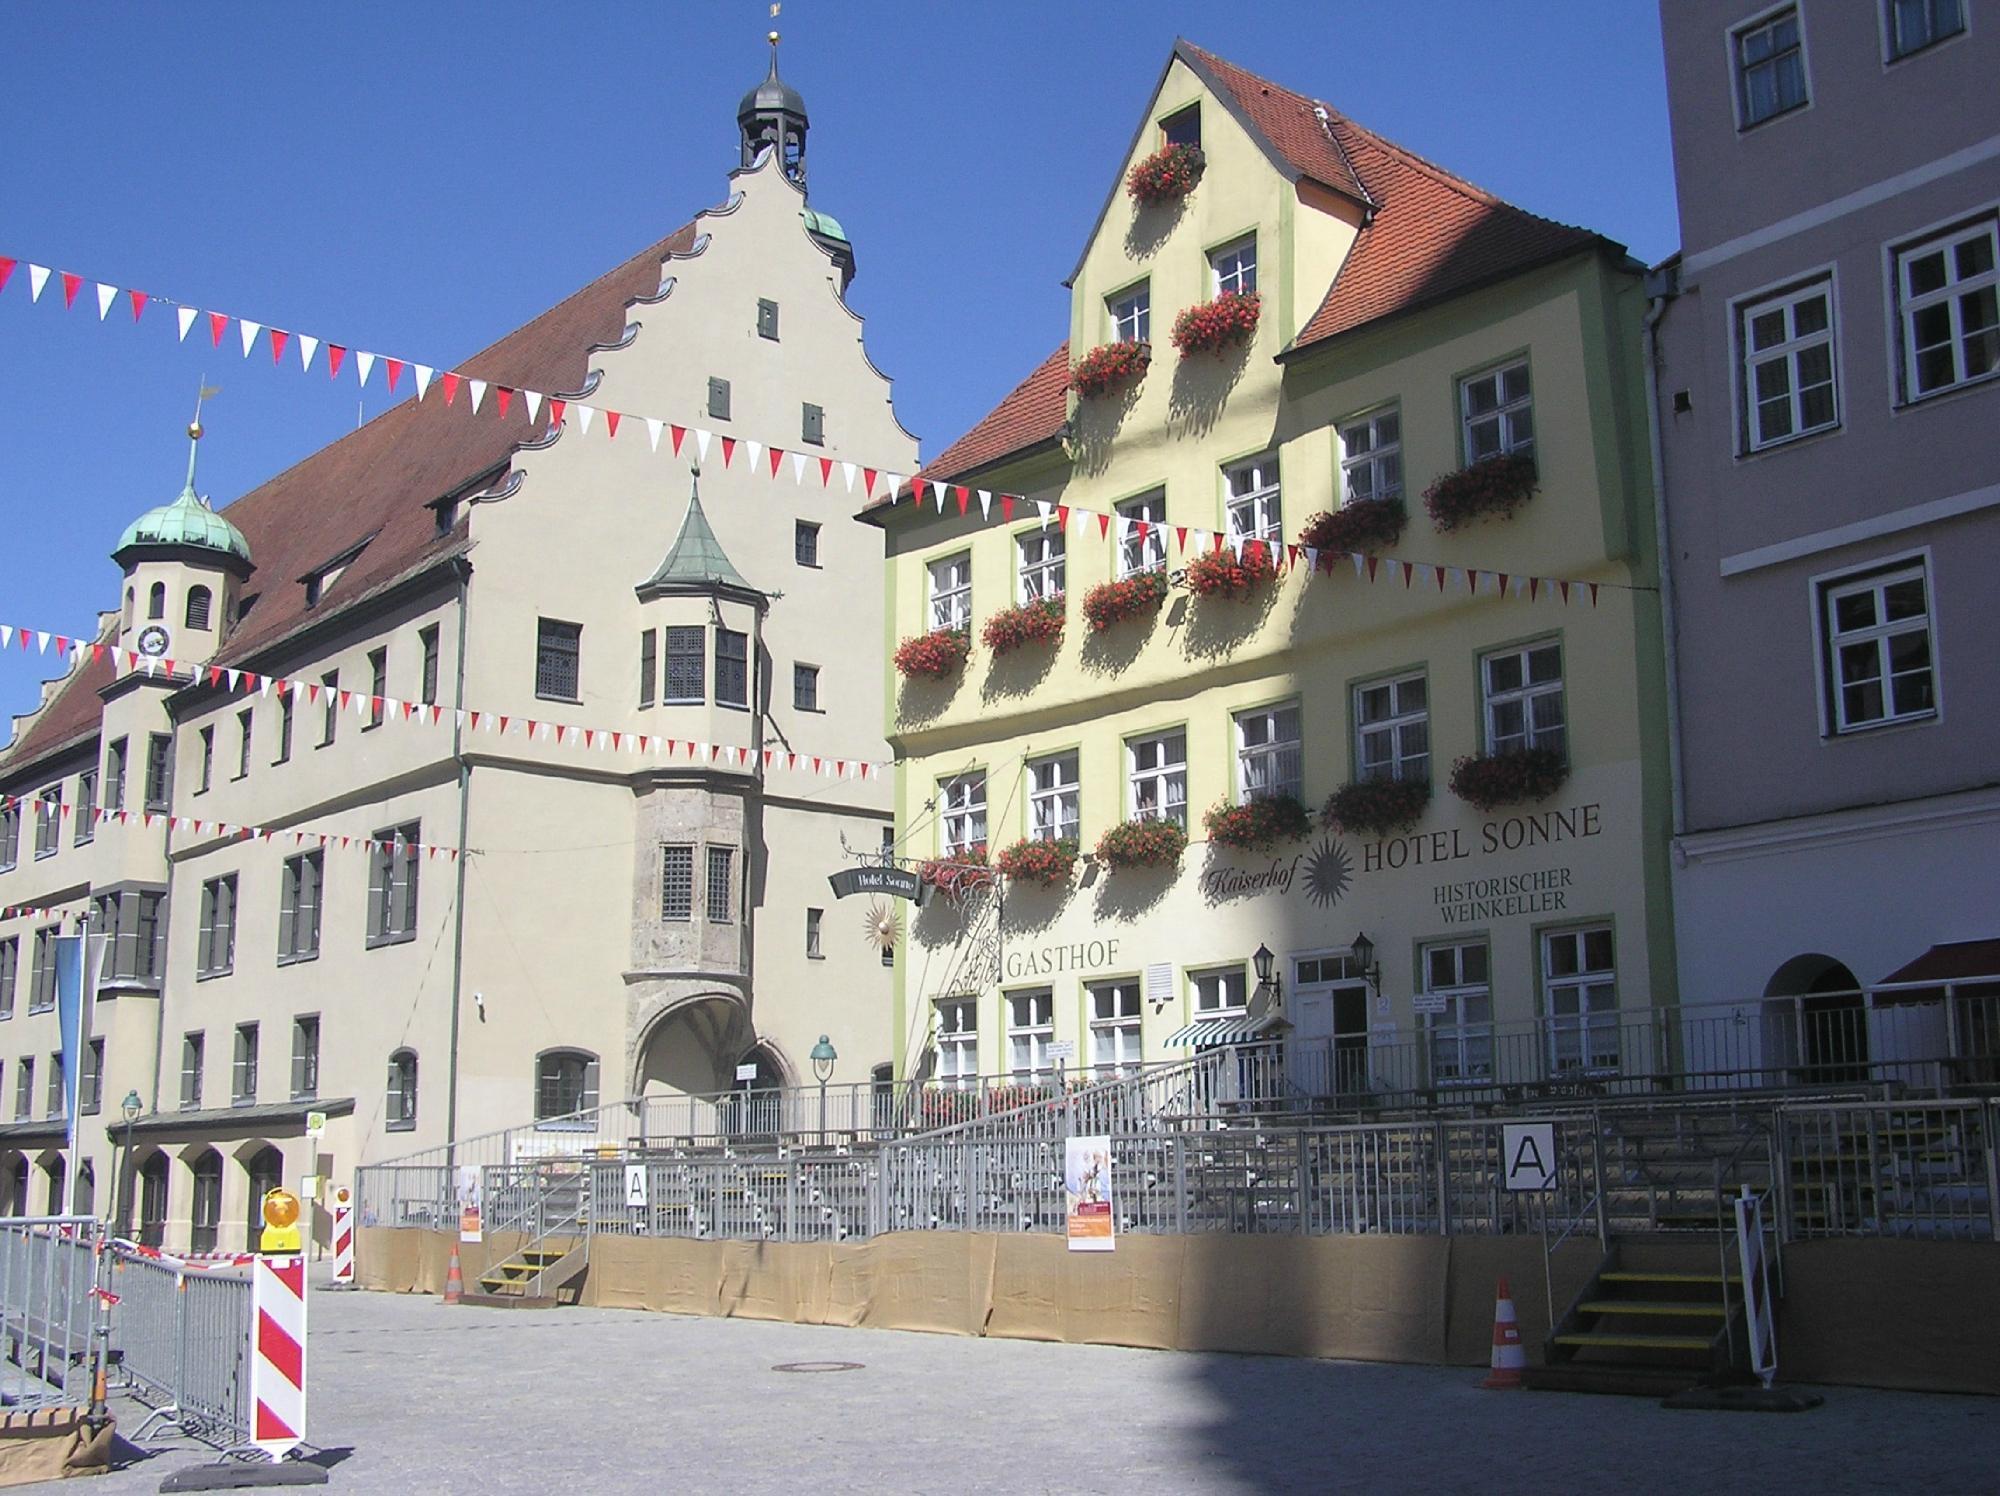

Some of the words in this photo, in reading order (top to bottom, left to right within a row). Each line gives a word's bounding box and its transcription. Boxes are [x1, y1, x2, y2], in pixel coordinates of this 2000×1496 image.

[1363, 828, 1470, 873] HOTEL
[1482, 803, 1602, 854] SONNE
[858, 873, 882, 887] Hotel
[1206, 855, 1302, 896] Kaiserhof
[1433, 868, 1573, 905] HISTORISCHER
[1441, 891, 1566, 924] WEINKELLER
[1007, 939, 1121, 978] GASTHOF
[1510, 1136, 1546, 1177] A
[630, 1172, 643, 1199] A
